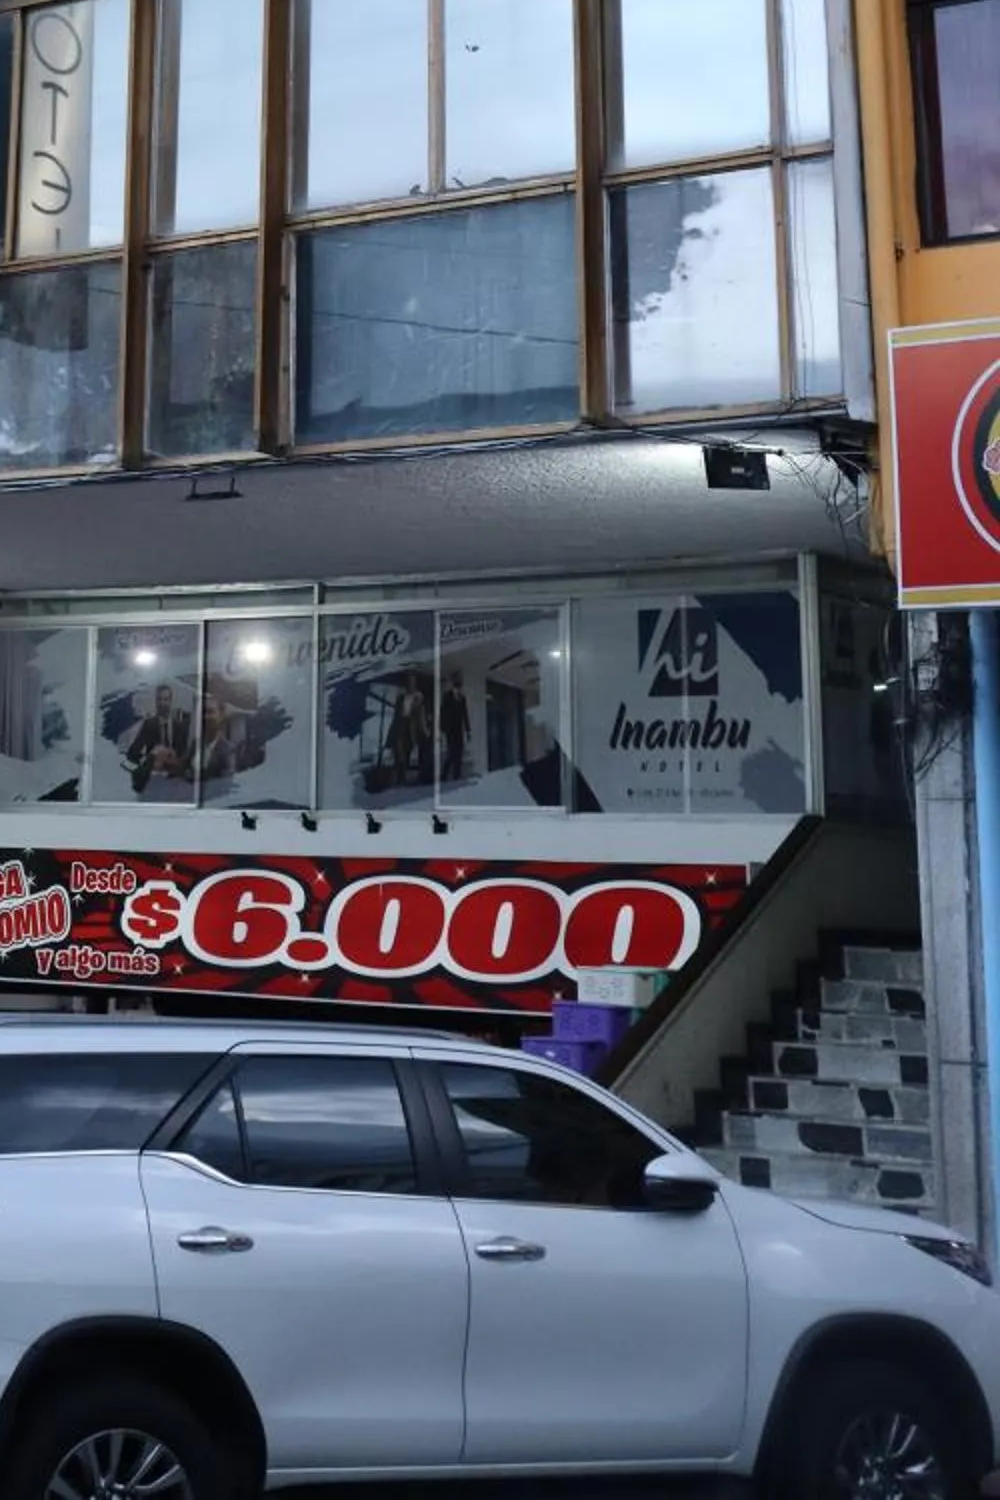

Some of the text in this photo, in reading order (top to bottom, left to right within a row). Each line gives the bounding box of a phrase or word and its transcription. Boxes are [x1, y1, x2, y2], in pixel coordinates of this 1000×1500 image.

[609, 699, 751, 751] Inambu
[71, 861, 136, 893] Desde
[122, 870, 701, 983] $6.000
[56, 948, 103, 977] algo
[109, 948, 159, 974] más
